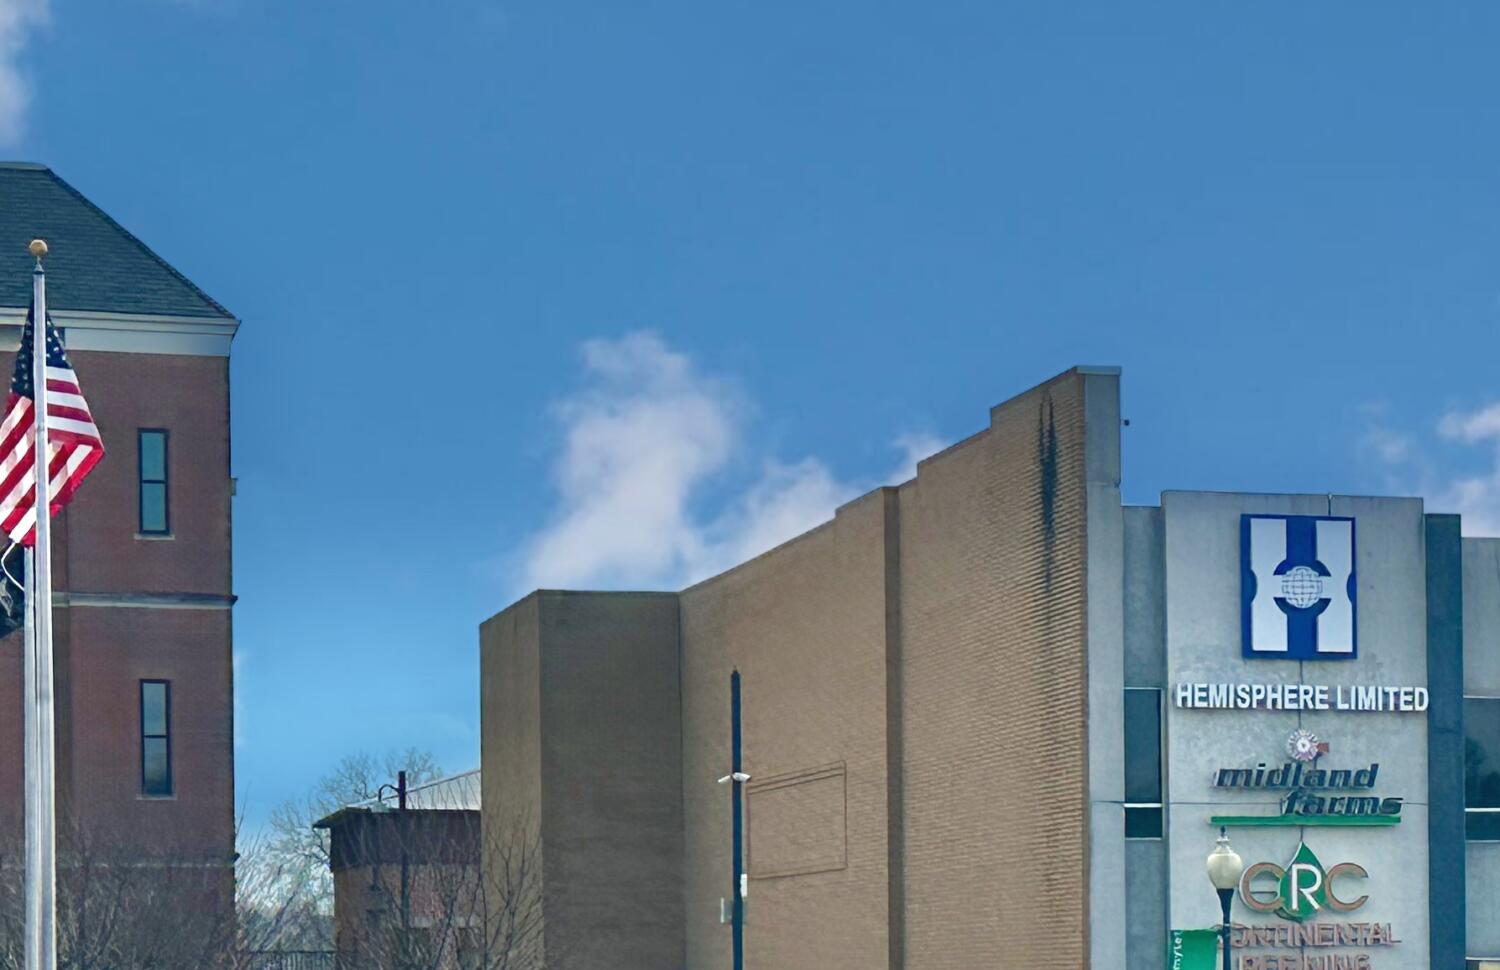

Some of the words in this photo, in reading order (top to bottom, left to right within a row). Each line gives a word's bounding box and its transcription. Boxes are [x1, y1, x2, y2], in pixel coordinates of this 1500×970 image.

[1176, 683, 1329, 710] HEMISPHERE
[1337, 685, 1430, 712] LIMITED
[1215, 763, 1380, 788] midland
[1282, 790, 1404, 815] farms
